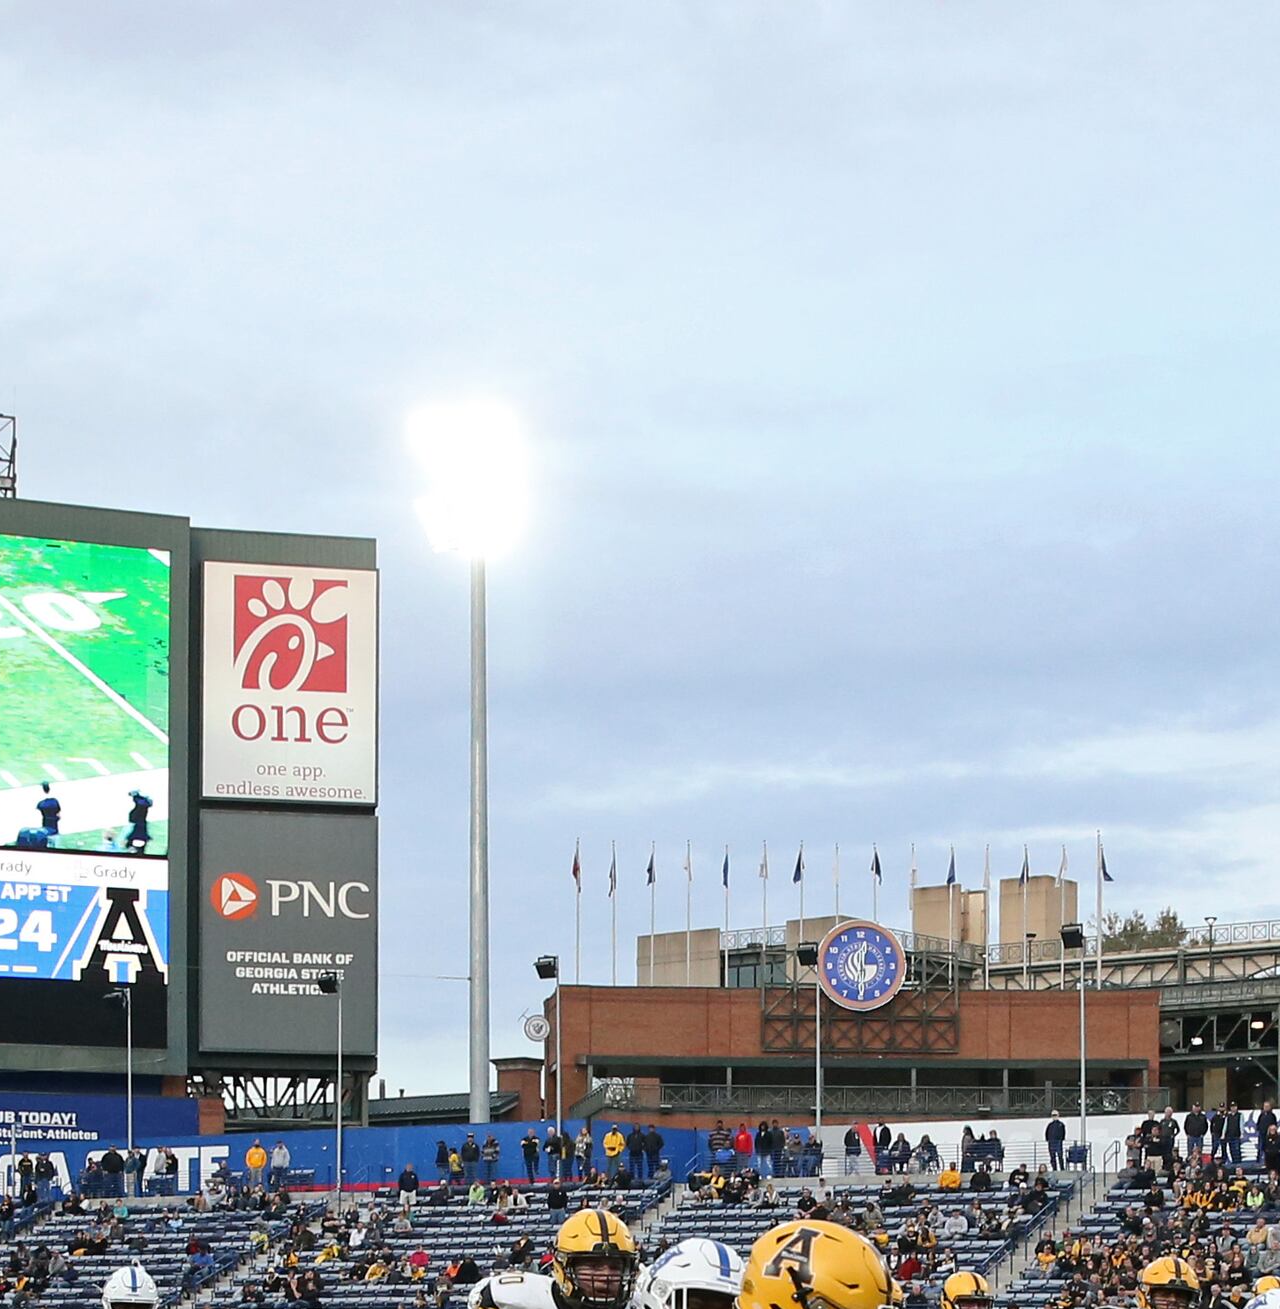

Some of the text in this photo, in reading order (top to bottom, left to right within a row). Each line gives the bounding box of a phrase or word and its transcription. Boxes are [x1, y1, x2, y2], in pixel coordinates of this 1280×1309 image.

[231, 703, 349, 744] one
[256, 764, 327, 781] one app.
[215, 780, 368, 800] endless awesome.
[92, 864, 137, 880] Grady
[0, 882, 42, 900] APP
[265, 879, 370, 919] PNC
[226, 951, 354, 965] OFFICIAL BANK OF
[235, 967, 298, 980] GEORGIA
[252, 983, 329, 996] ATHLETIC
[18, 1111, 77, 1127] TODAY!
